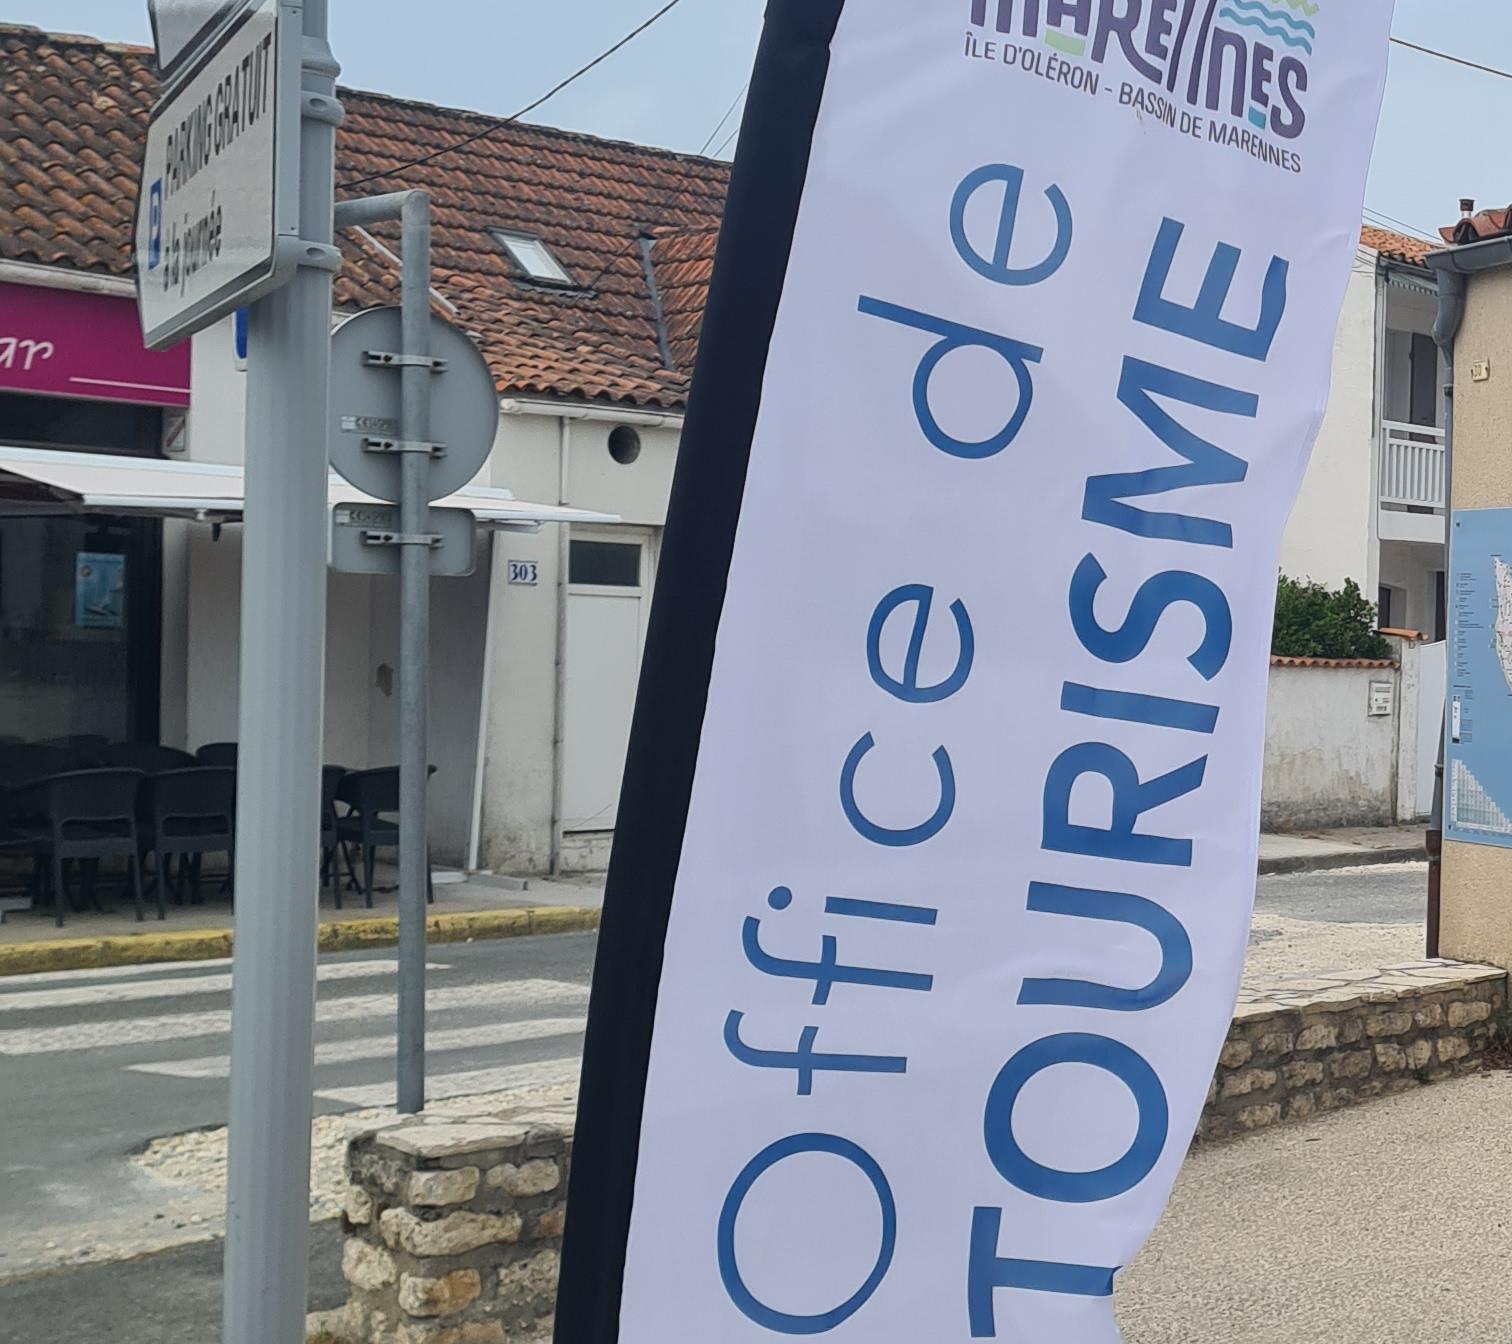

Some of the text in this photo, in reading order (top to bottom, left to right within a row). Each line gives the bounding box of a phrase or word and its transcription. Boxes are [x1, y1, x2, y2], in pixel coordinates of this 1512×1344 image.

[164, 91, 212, 202] PARKING
[213, 31, 272, 157] GRATUIT
[963, 30, 996, 61] ÎLE
[1002, 46, 1100, 96] D'OLÉRON
[1118, 82, 1176, 129] BASSIN
[1180, 111, 1203, 140] DE
[1208, 120, 1302, 174] MARENNES
[170, 222, 180, 286] la
[511, 563, 537, 581] 303
[717, 162, 1073, 1336] Office de
[967, 216, 1289, 1338] TOURISME
